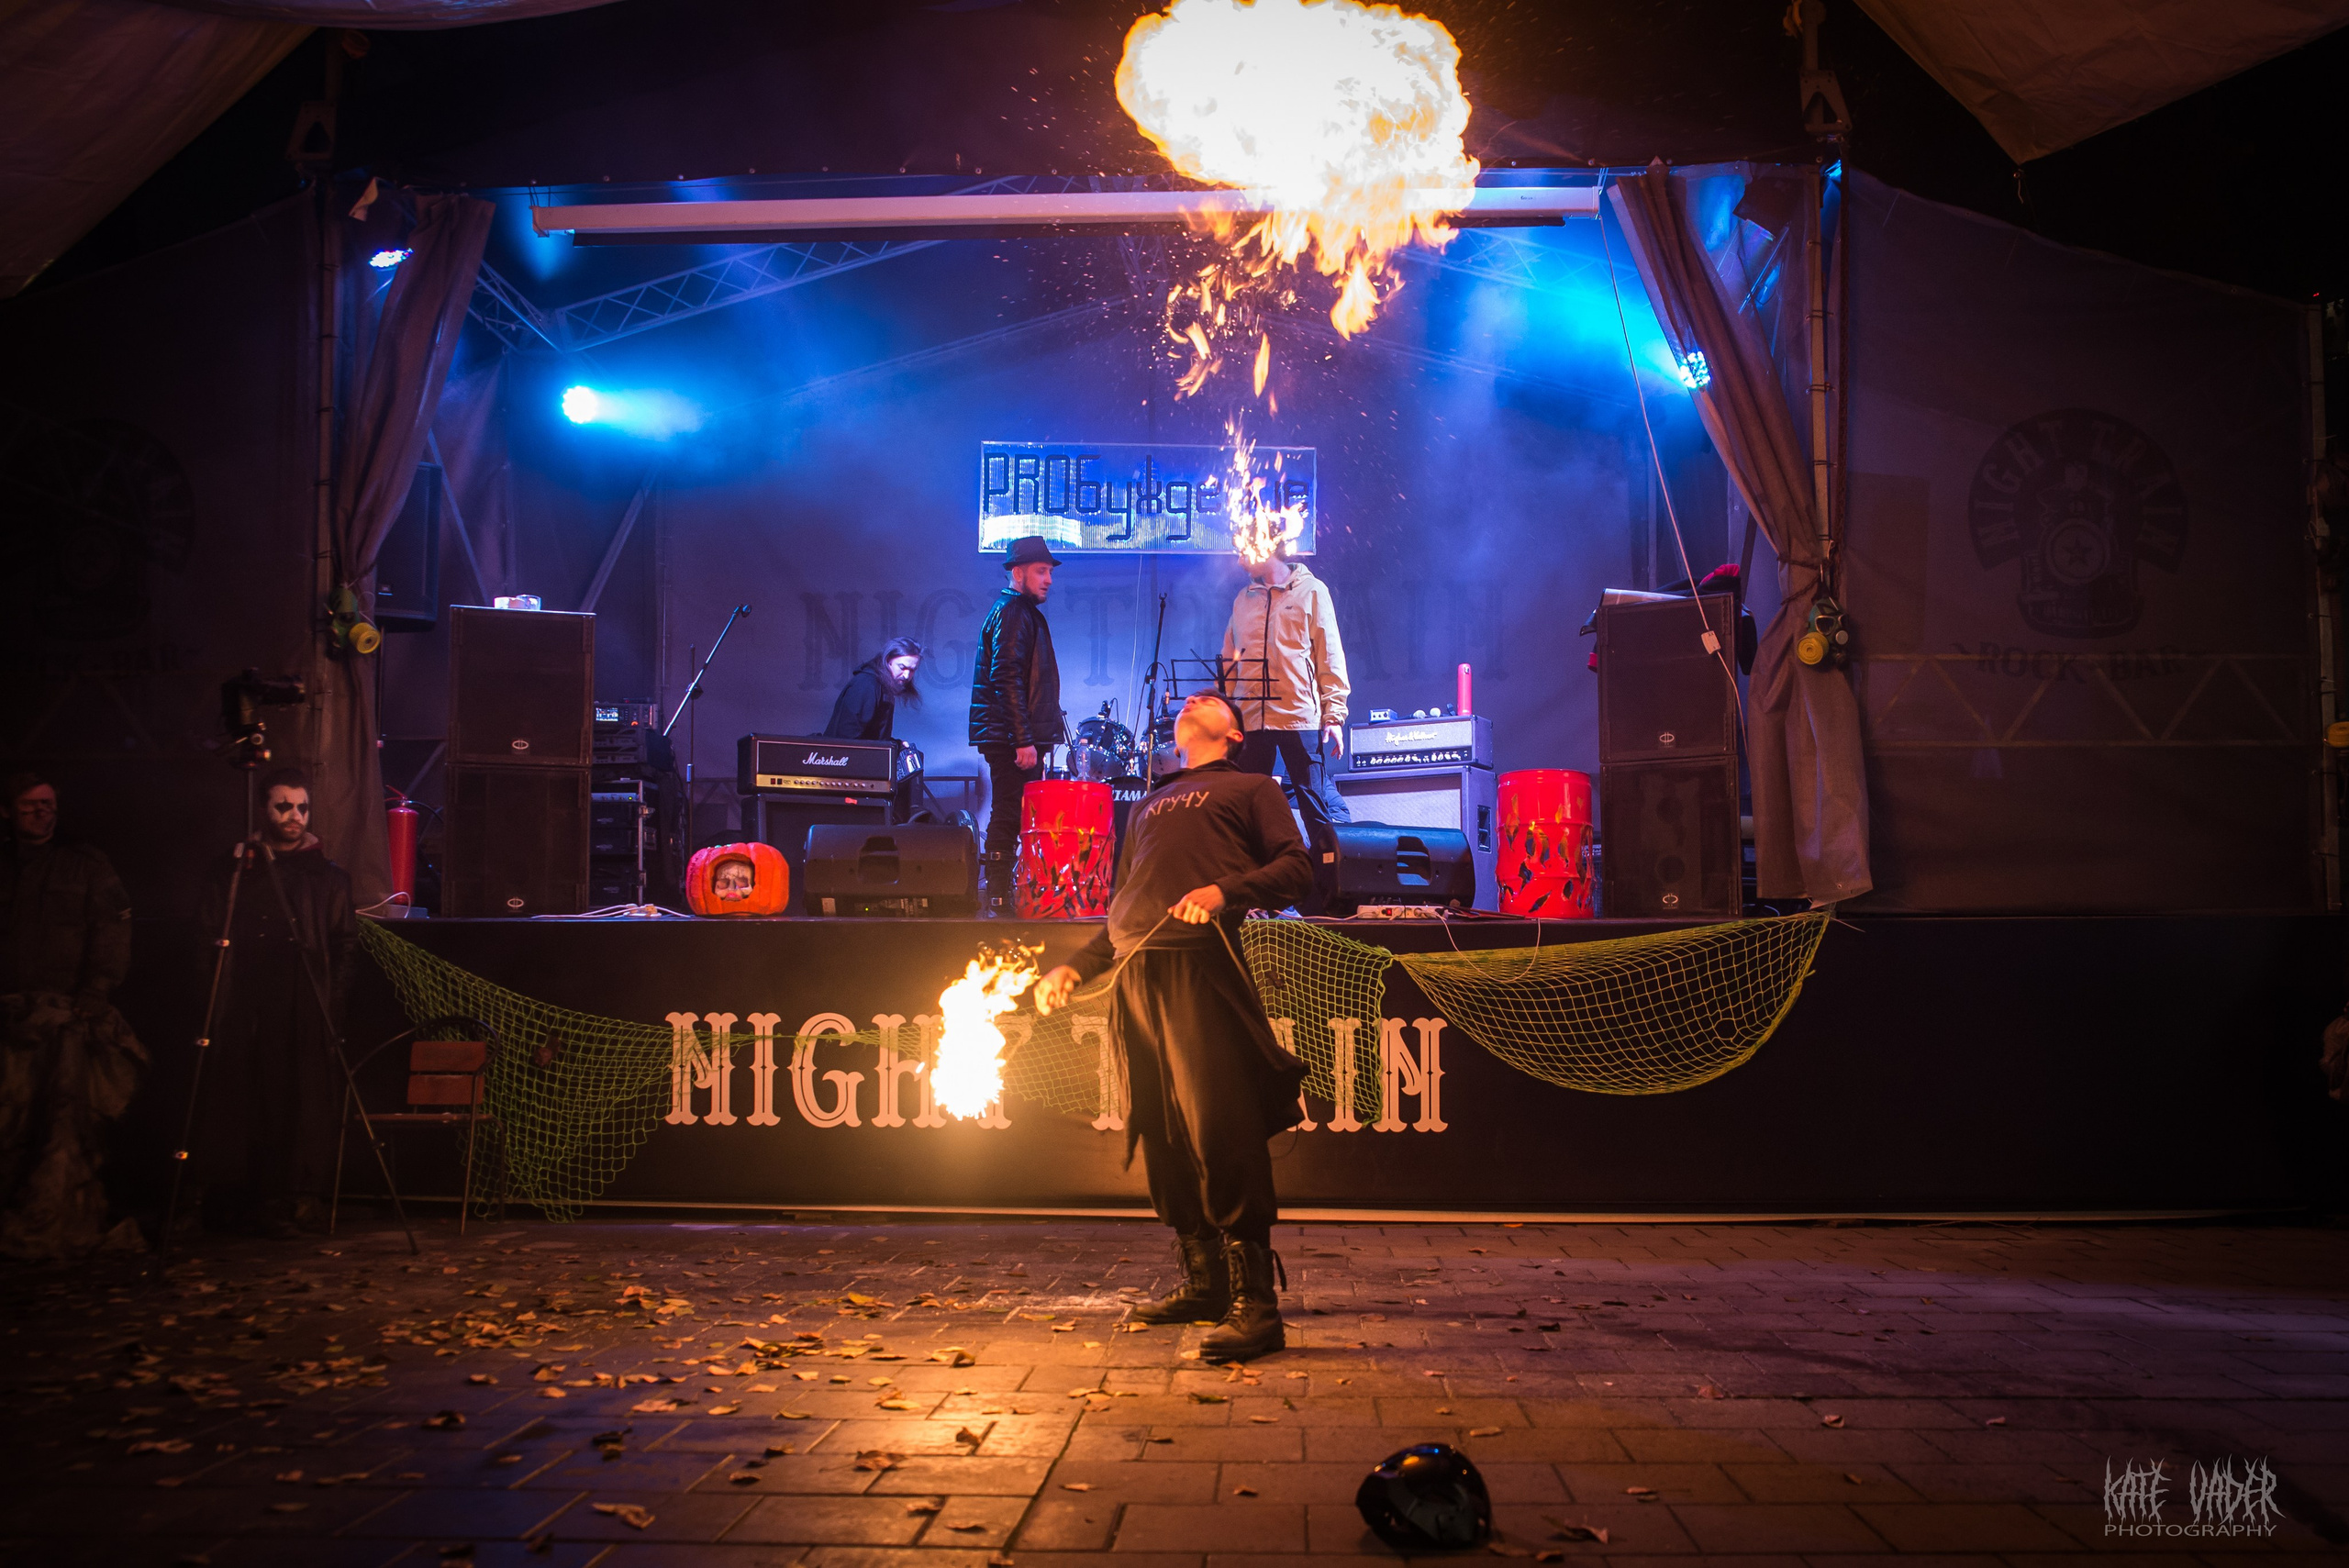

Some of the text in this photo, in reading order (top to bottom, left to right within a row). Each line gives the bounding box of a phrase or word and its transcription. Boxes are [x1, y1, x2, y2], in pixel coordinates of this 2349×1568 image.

[797, 586, 1136, 692] NIGT
[802, 751, 849, 766] Marshall
[1070, 1013, 1449, 1133] TIN
